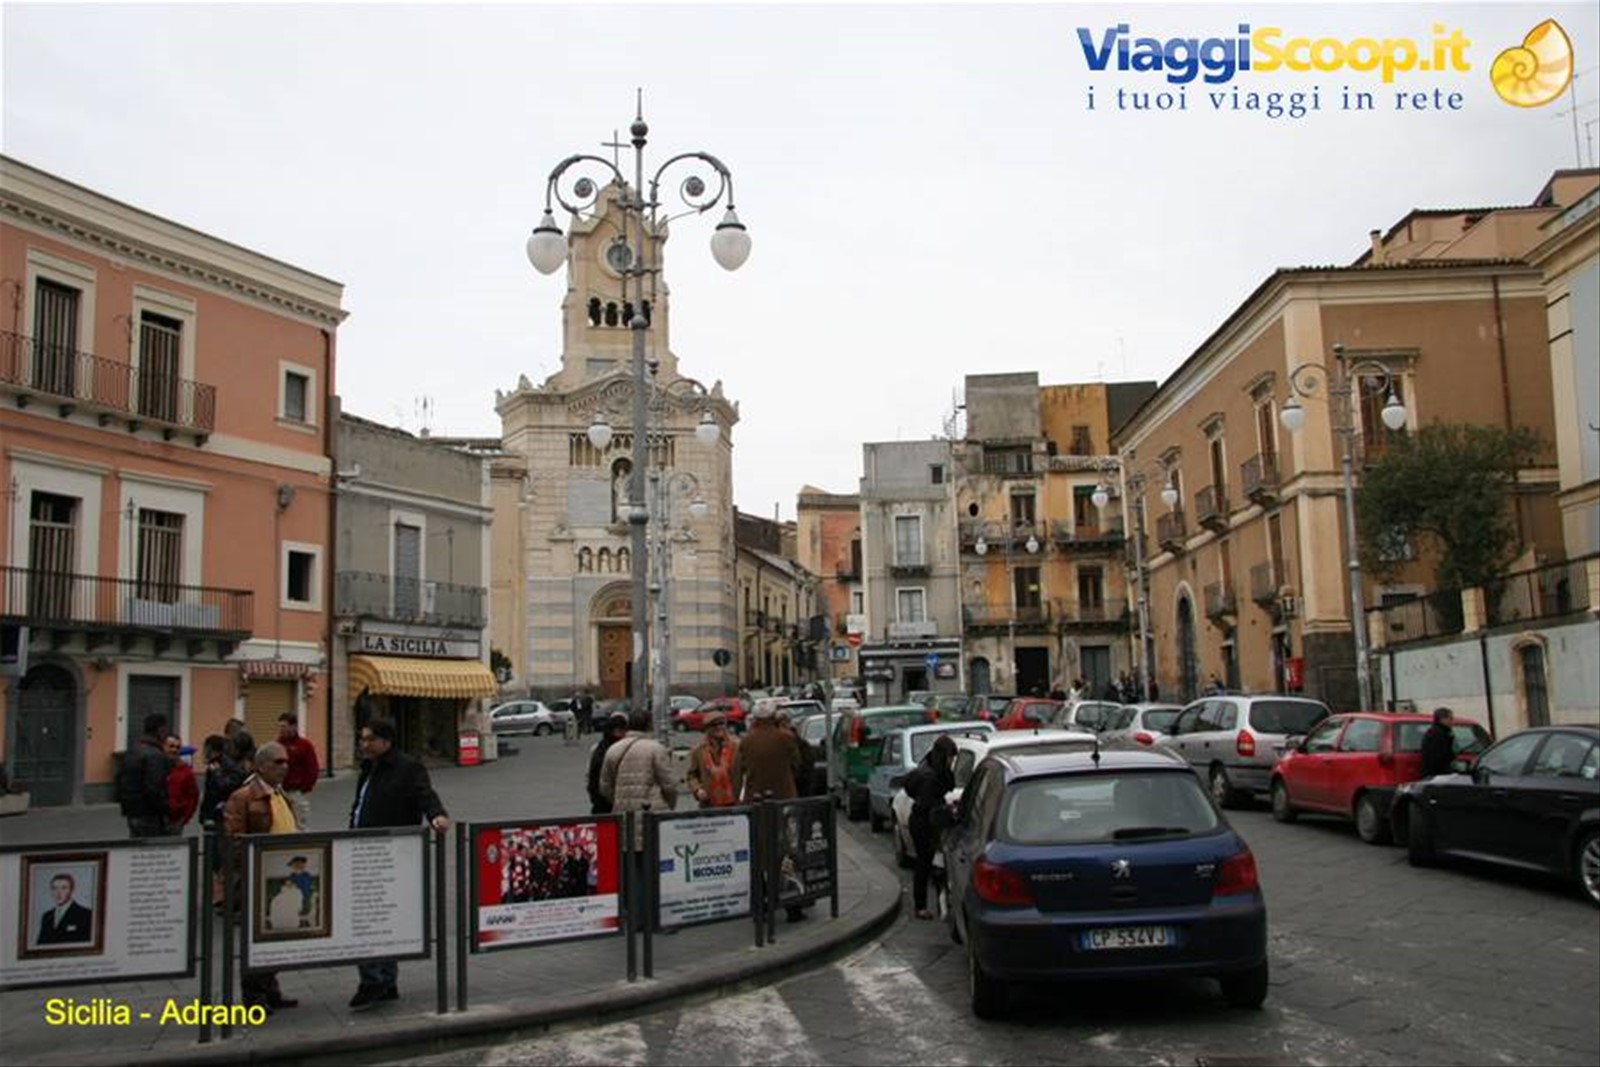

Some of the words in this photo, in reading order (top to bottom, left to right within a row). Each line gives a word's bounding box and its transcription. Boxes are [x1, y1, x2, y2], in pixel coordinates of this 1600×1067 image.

[365, 636, 386, 650] LA
[390, 638, 447, 655] SICILIA
[1092, 928, 1111, 947] CP
